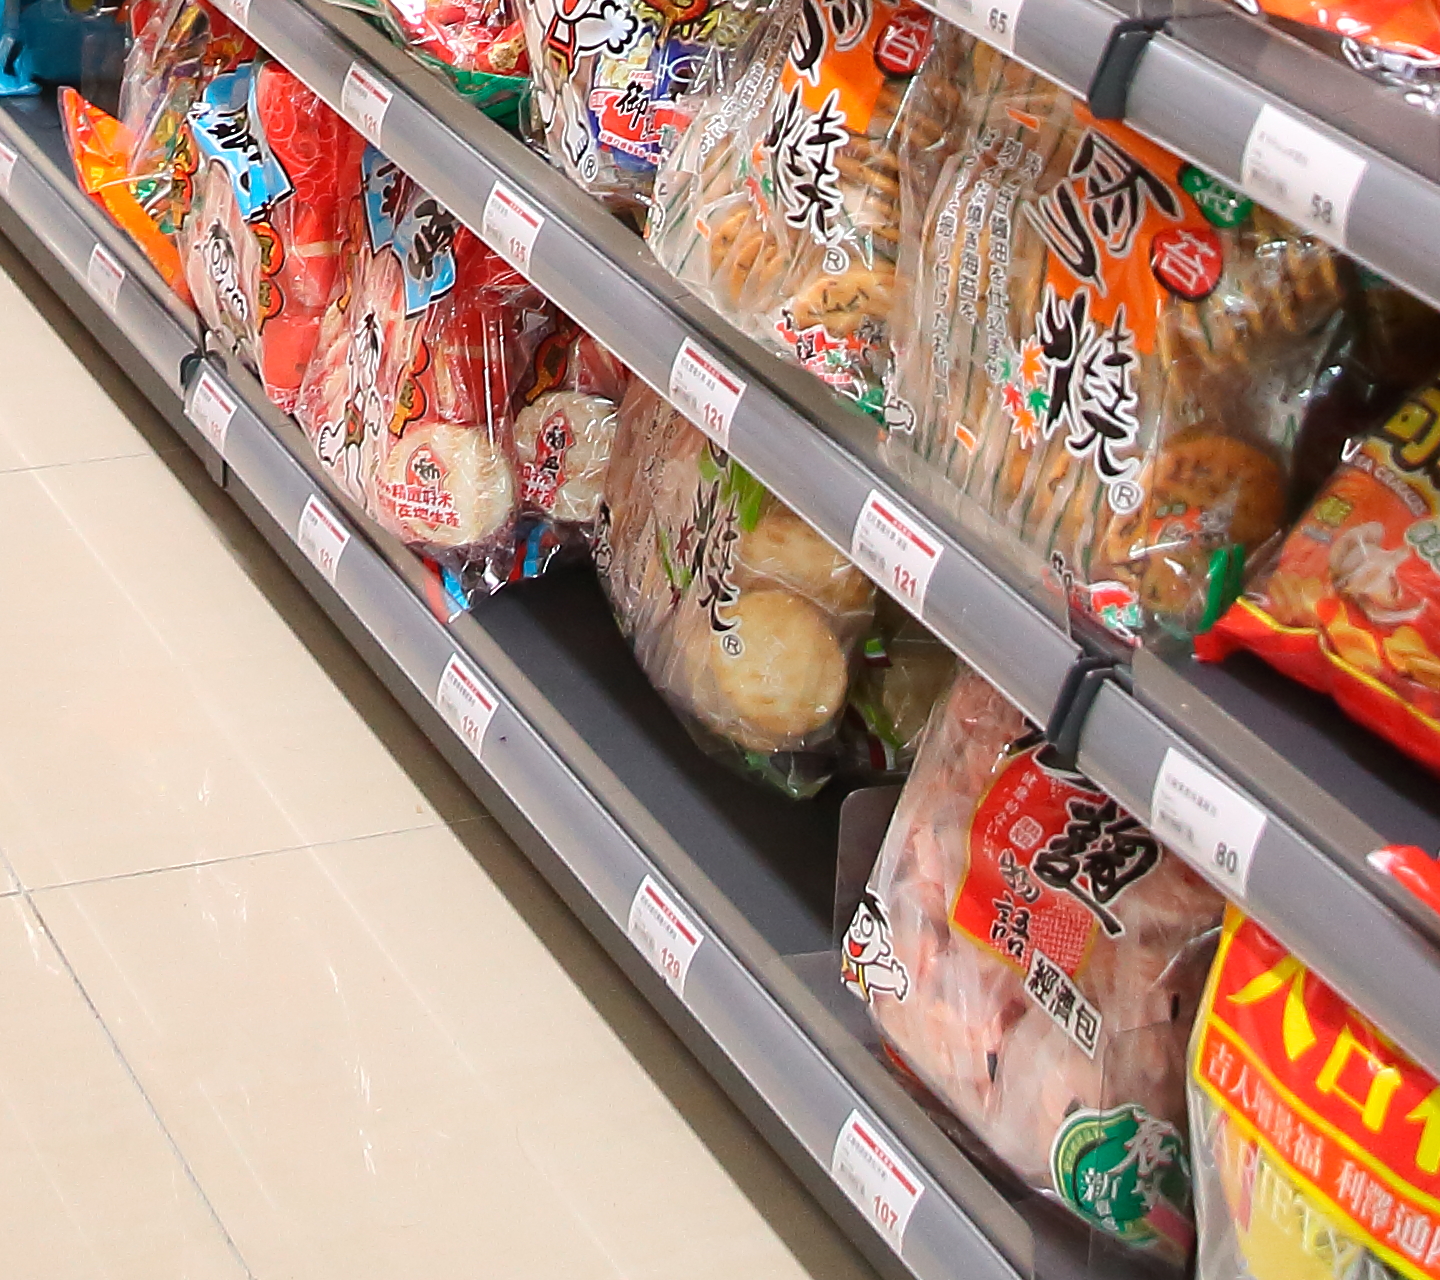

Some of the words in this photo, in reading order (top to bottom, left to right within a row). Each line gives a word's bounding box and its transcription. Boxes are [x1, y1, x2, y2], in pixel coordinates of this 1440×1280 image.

[988, 7, 1008, 35] 65
[1311, 195, 1333, 227] 58
[703, 404, 724, 429] 121
[892, 566, 918, 597] 121
[1215, 842, 1239, 876] 80
[1027, 954, 1100, 1048] 經濟包
[874, 1196, 899, 1228] 107
